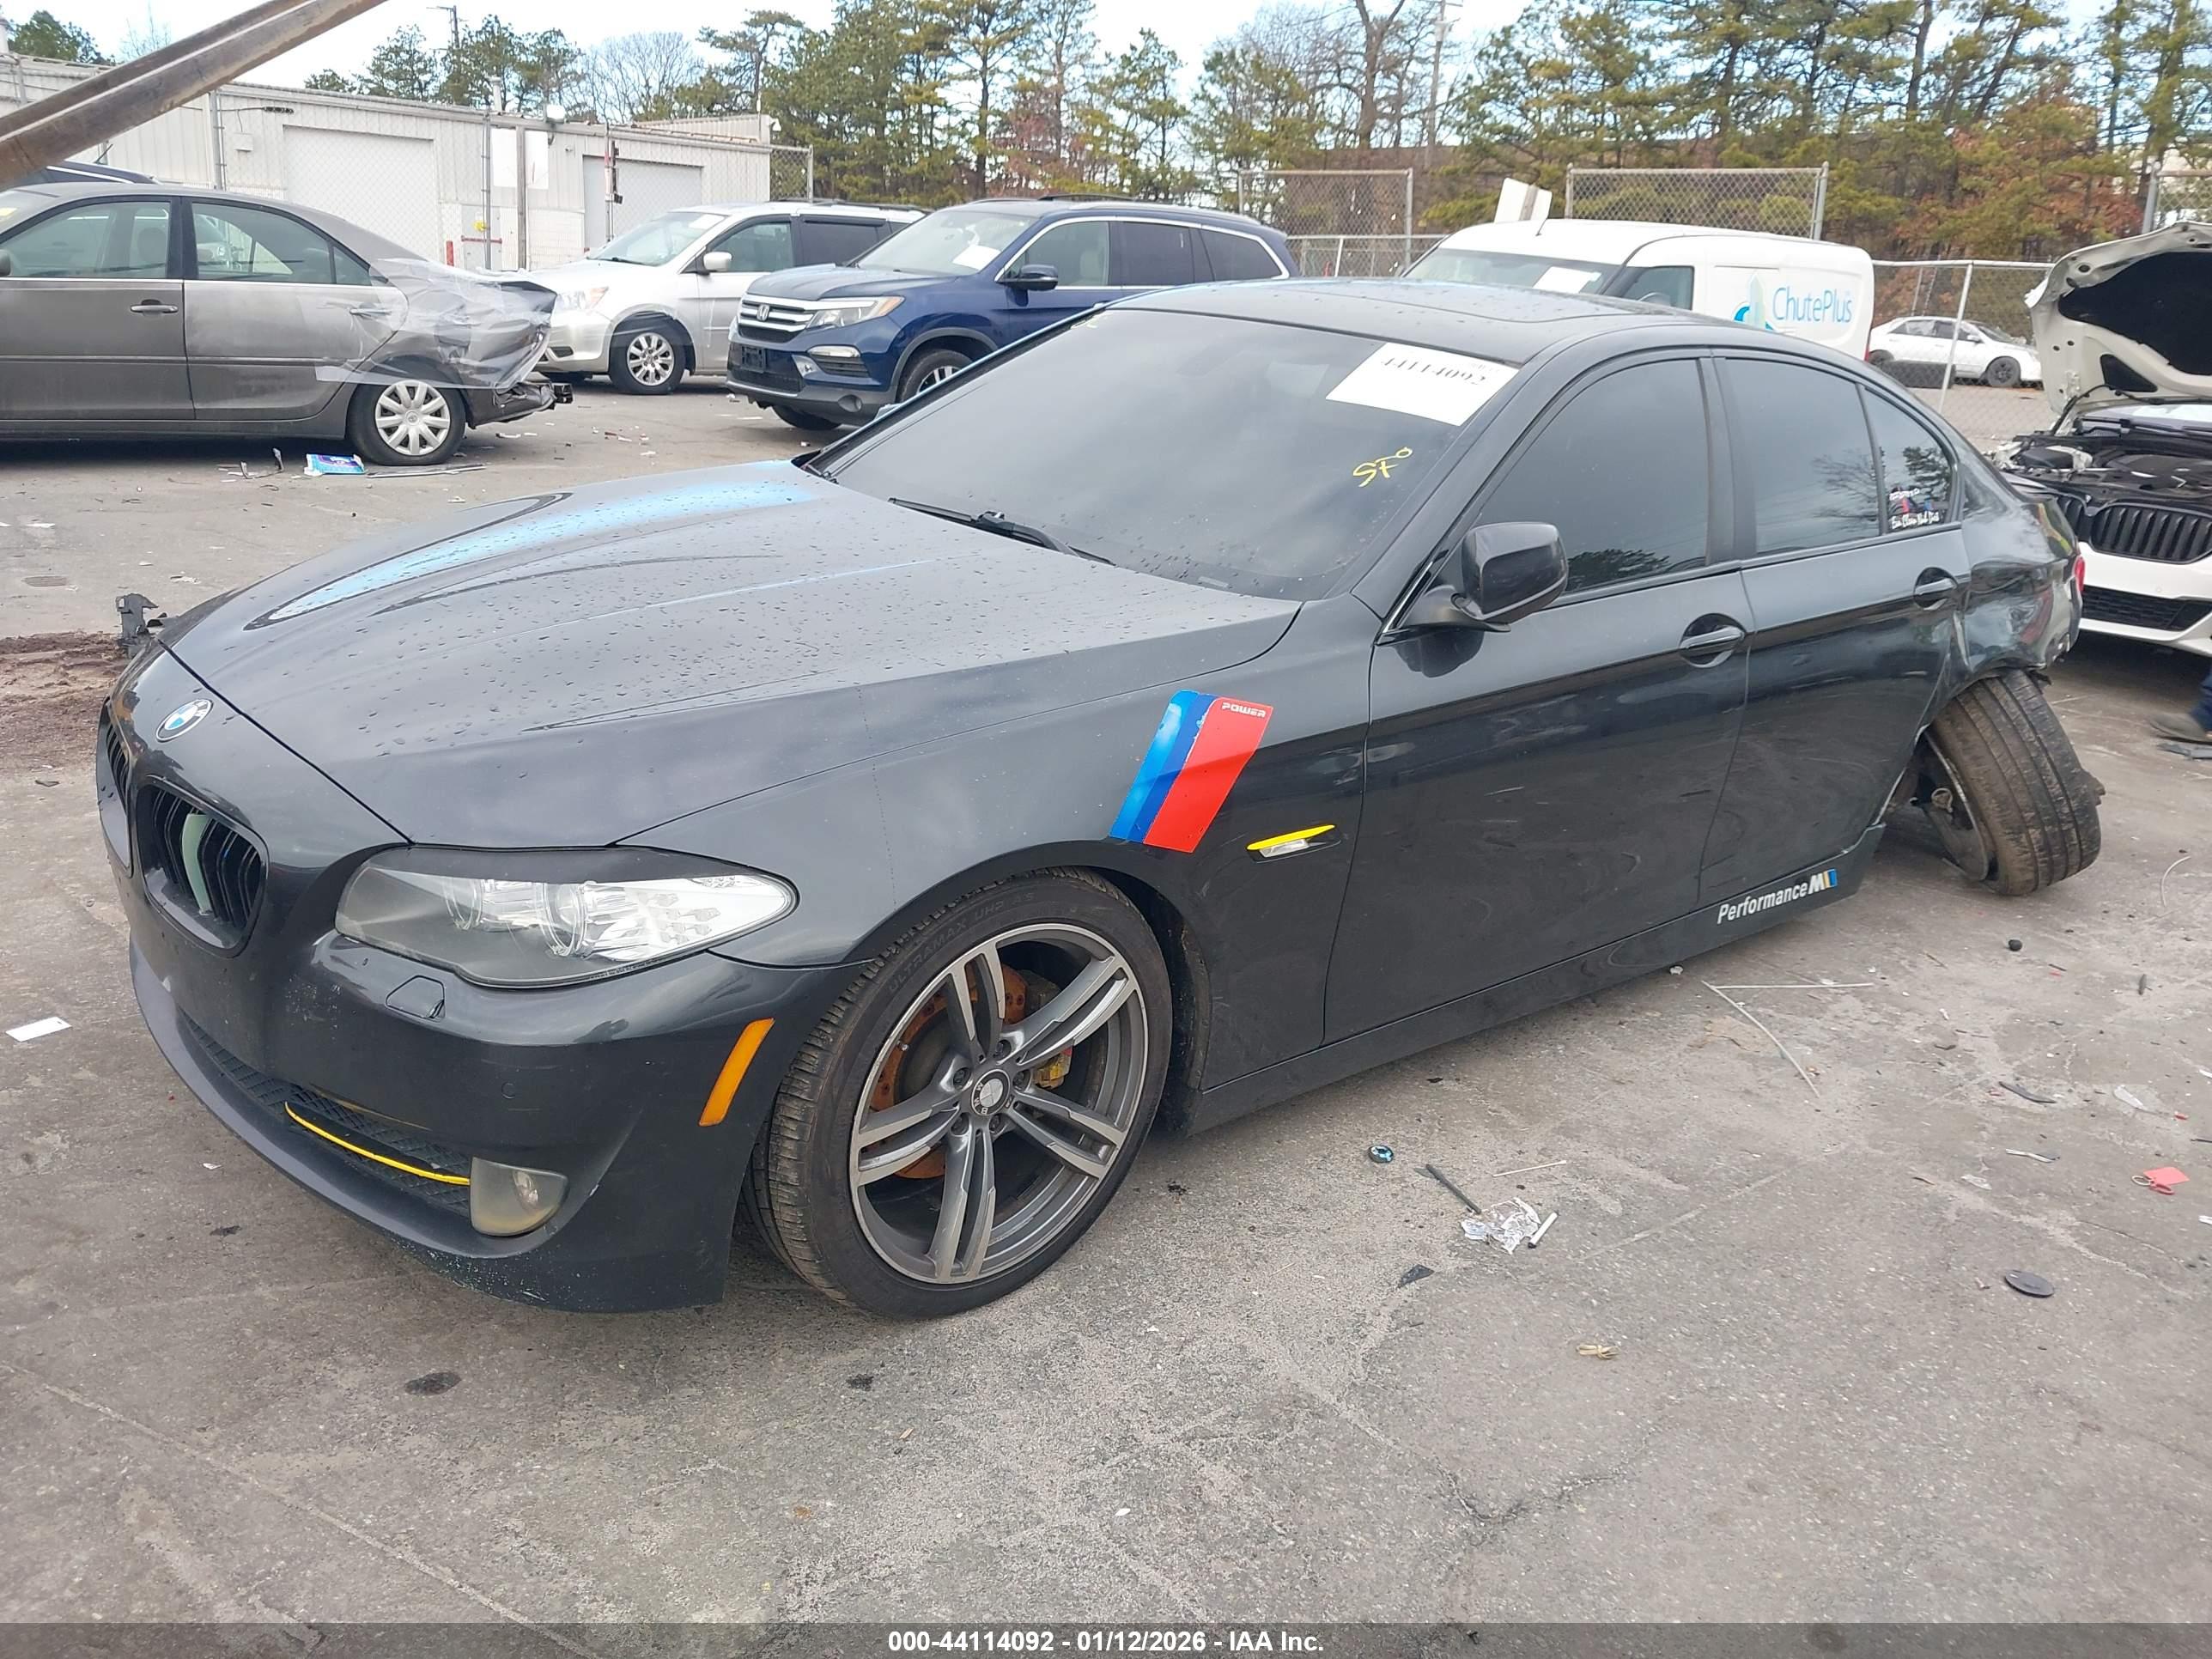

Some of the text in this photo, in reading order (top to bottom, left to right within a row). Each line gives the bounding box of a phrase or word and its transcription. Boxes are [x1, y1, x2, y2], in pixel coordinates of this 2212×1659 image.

[1772, 286, 1852, 323] ChutePlus
[1222, 702, 1267, 718] POWER
[1717, 882, 1808, 925] Performance
